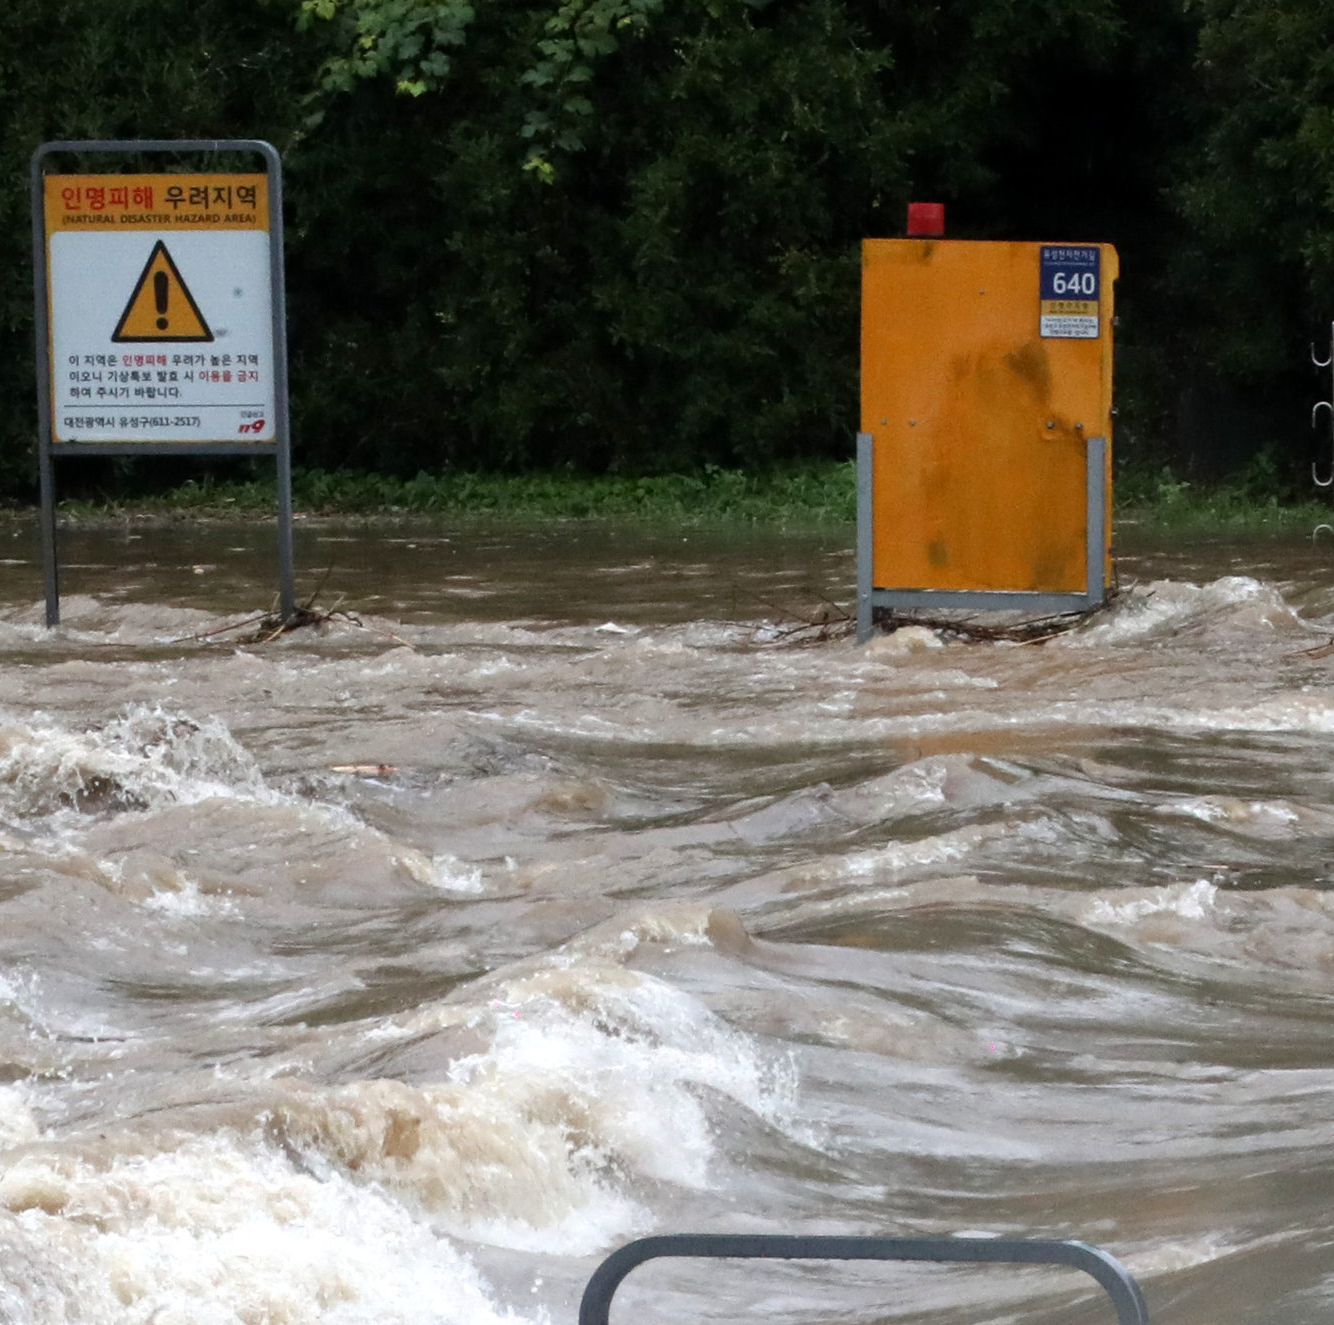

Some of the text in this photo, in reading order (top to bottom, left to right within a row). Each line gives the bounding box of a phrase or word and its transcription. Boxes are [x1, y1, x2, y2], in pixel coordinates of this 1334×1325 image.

[62, 185, 256, 210] 인명피해 우려지역
[63, 214, 255, 224] (NATURAL DISASTER HAZARD AREA)
[1053, 272, 1095, 294] 640
[69, 355, 258, 367] 이 지역은 인명피해 우려가 높은 지역
[69, 372, 102, 383] 이오니
[108, 371, 151, 382] 기상특보
[157, 371, 178, 382] 발효
[184, 371, 194, 383] 시
[237, 371, 258, 382] 금지
[70, 387, 182, 399] 하여 주시기 바랍니다.
[64, 416, 200, 428] 대전광역시 유성구(611-2517)
